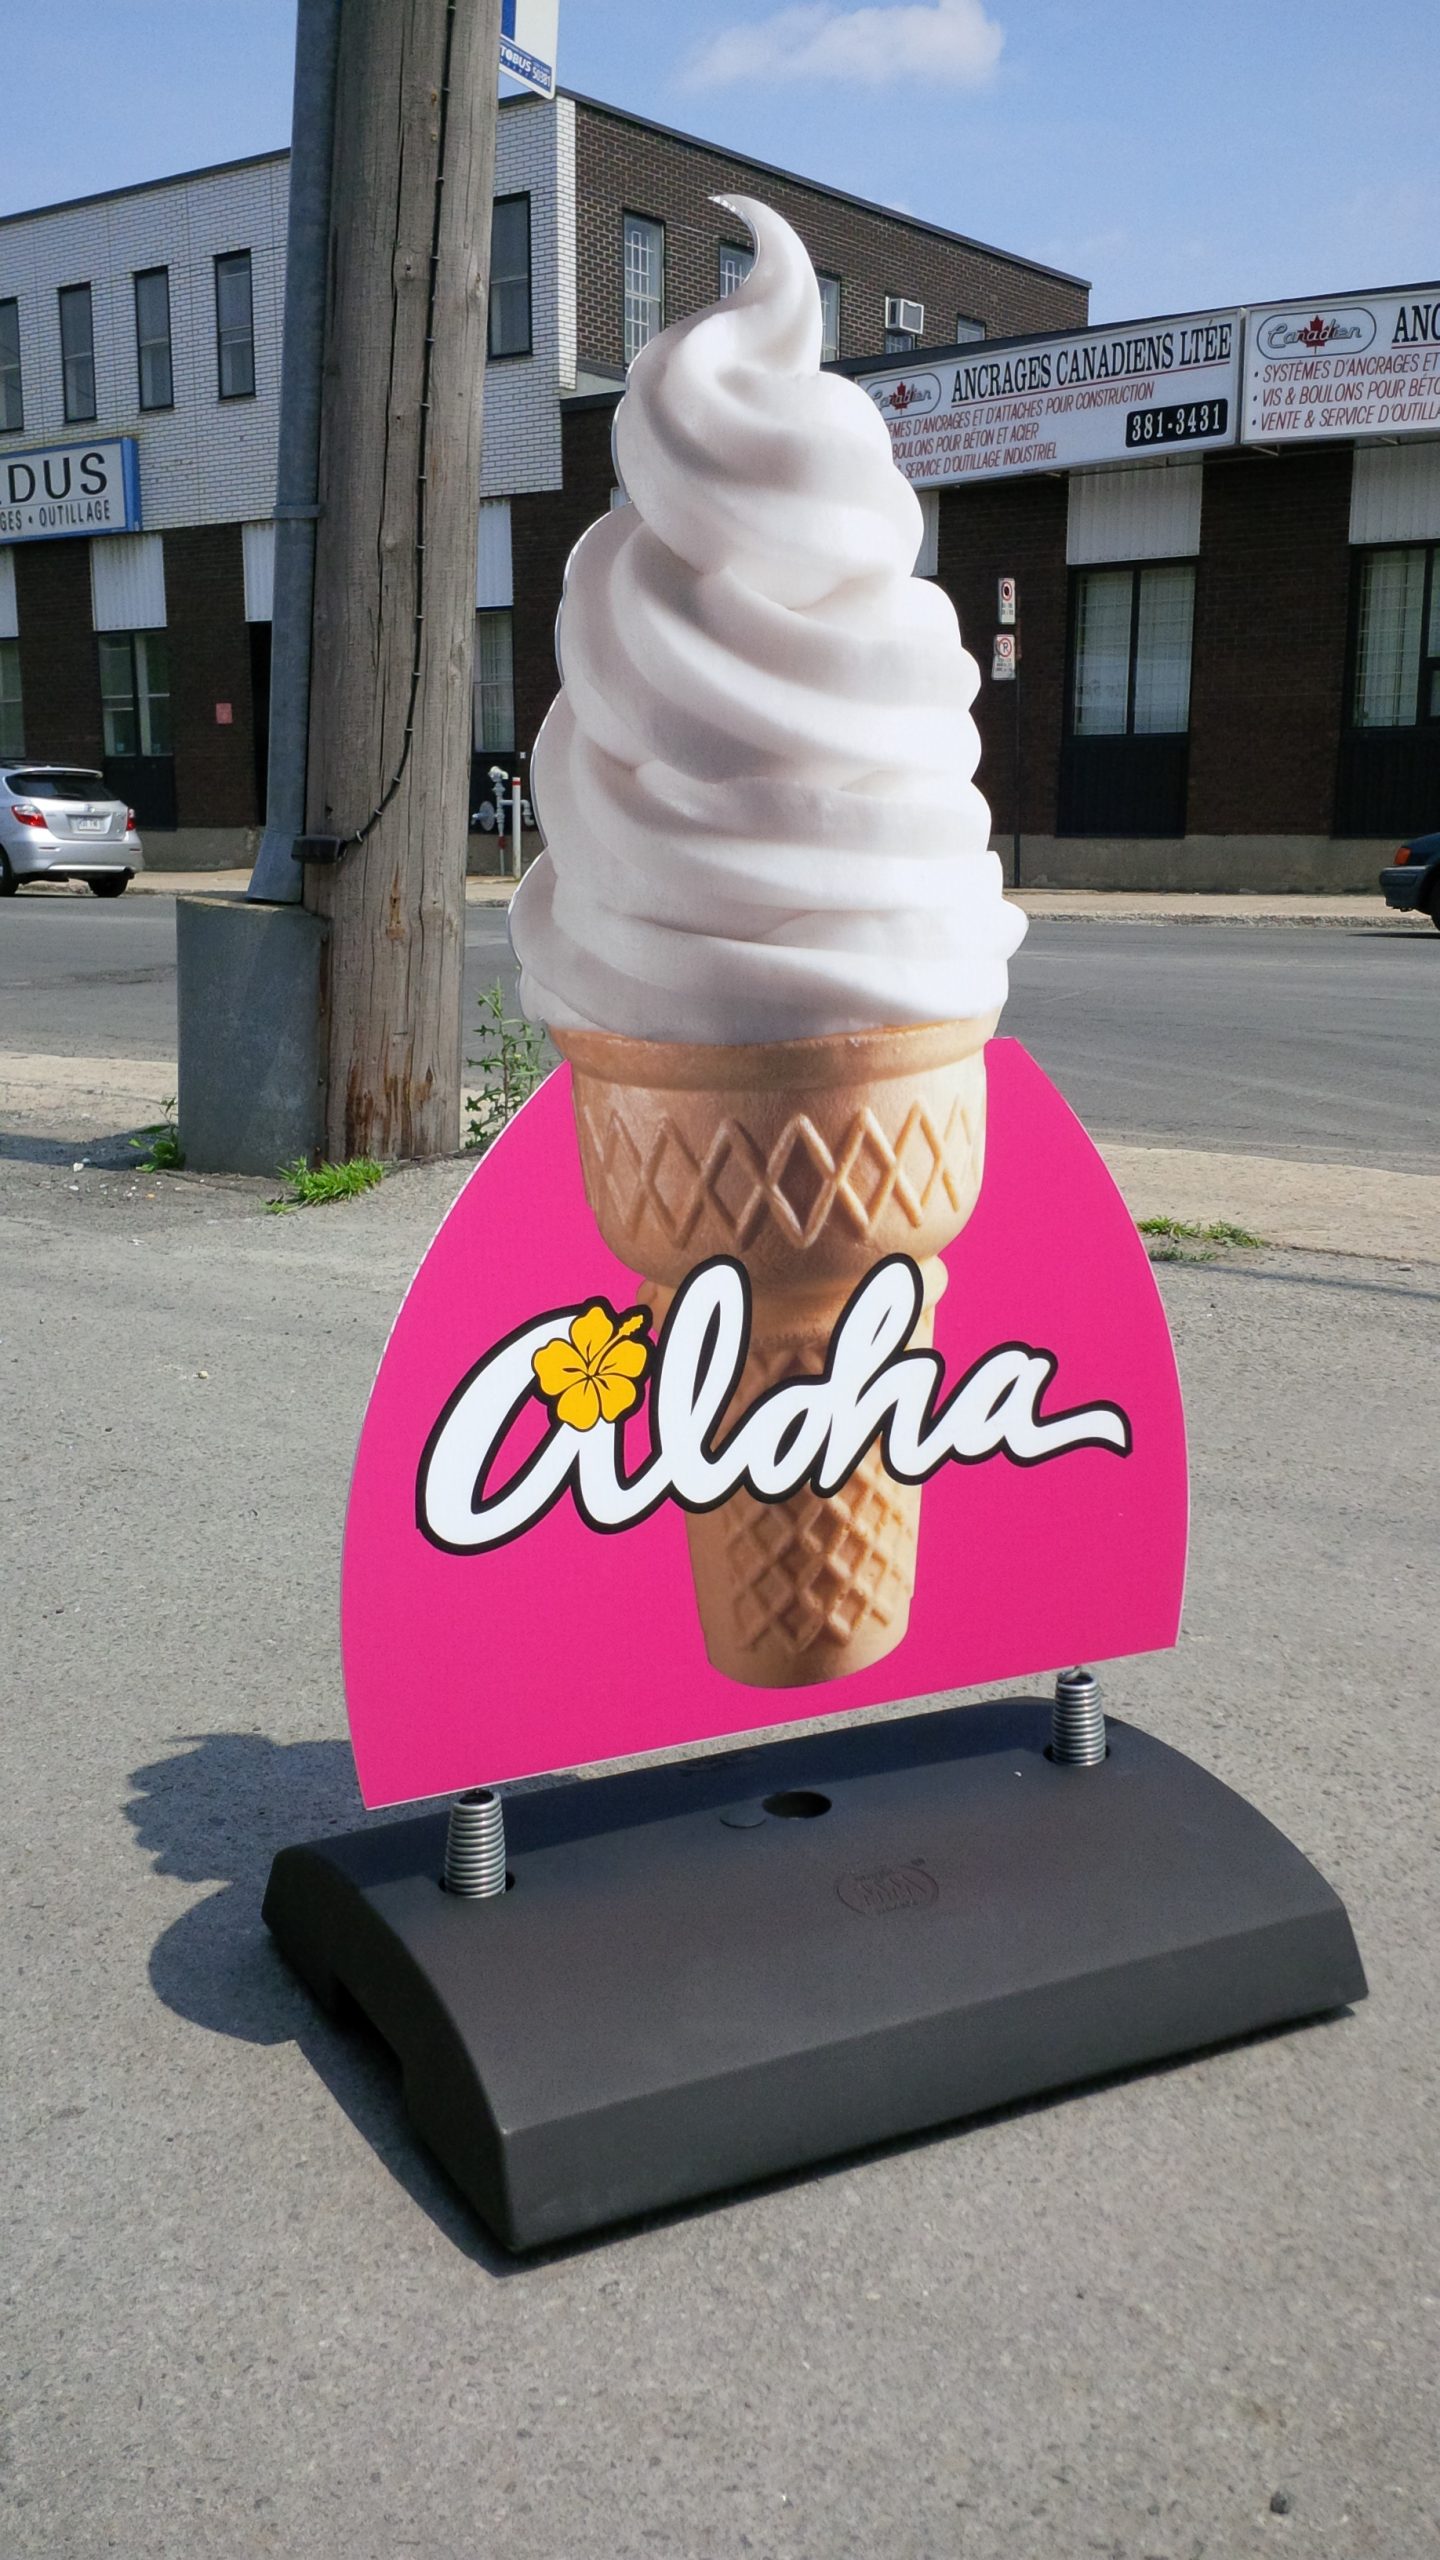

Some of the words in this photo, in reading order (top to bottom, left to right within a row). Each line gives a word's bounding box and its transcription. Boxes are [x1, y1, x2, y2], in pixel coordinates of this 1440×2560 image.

[1267, 318, 1362, 350] Canadien
[951, 353, 1051, 403] ANCRAGES
[1056, 333, 1174, 386] CANADIENS
[1179, 320, 1232, 366] LTÉE
[1334, 353, 1420, 378] D'ANCRAGES
[1423, 352, 1440, 372] ET
[913, 411, 970, 436] D'ANCRAGES
[972, 408, 984, 427] ET
[987, 401, 1043, 425] D'ATTACHES
[1045, 395, 1074, 415] POUR
[1075, 381, 1154, 410] CONSTRUCTION
[1263, 387, 1283, 407] VIS
[1285, 386, 1296, 406] &
[1299, 381, 1364, 405] BOULONS
[1367, 378, 1405, 400] POUR
[1132, 403, 1220, 441] 381-3431
[1261, 410, 1302, 431] VENTE
[1304, 409, 1315, 429] &
[1319, 405, 1375, 427] SERVICE
[893, 438, 934, 459] BOULONS
[936, 433, 963, 454] POUR
[963, 428, 993, 449] BÉTON
[996, 426, 1009, 444] ET
[1010, 422, 1040, 442] ACIER
[0, 452, 107, 504] DUS
[905, 458, 941, 479] SERVICE
[943, 450, 1000, 474] D'OUTILLAGE
[1003, 441, 1057, 465] INDUSTRIEL
[39, 499, 110, 527] OUTILLAGE
